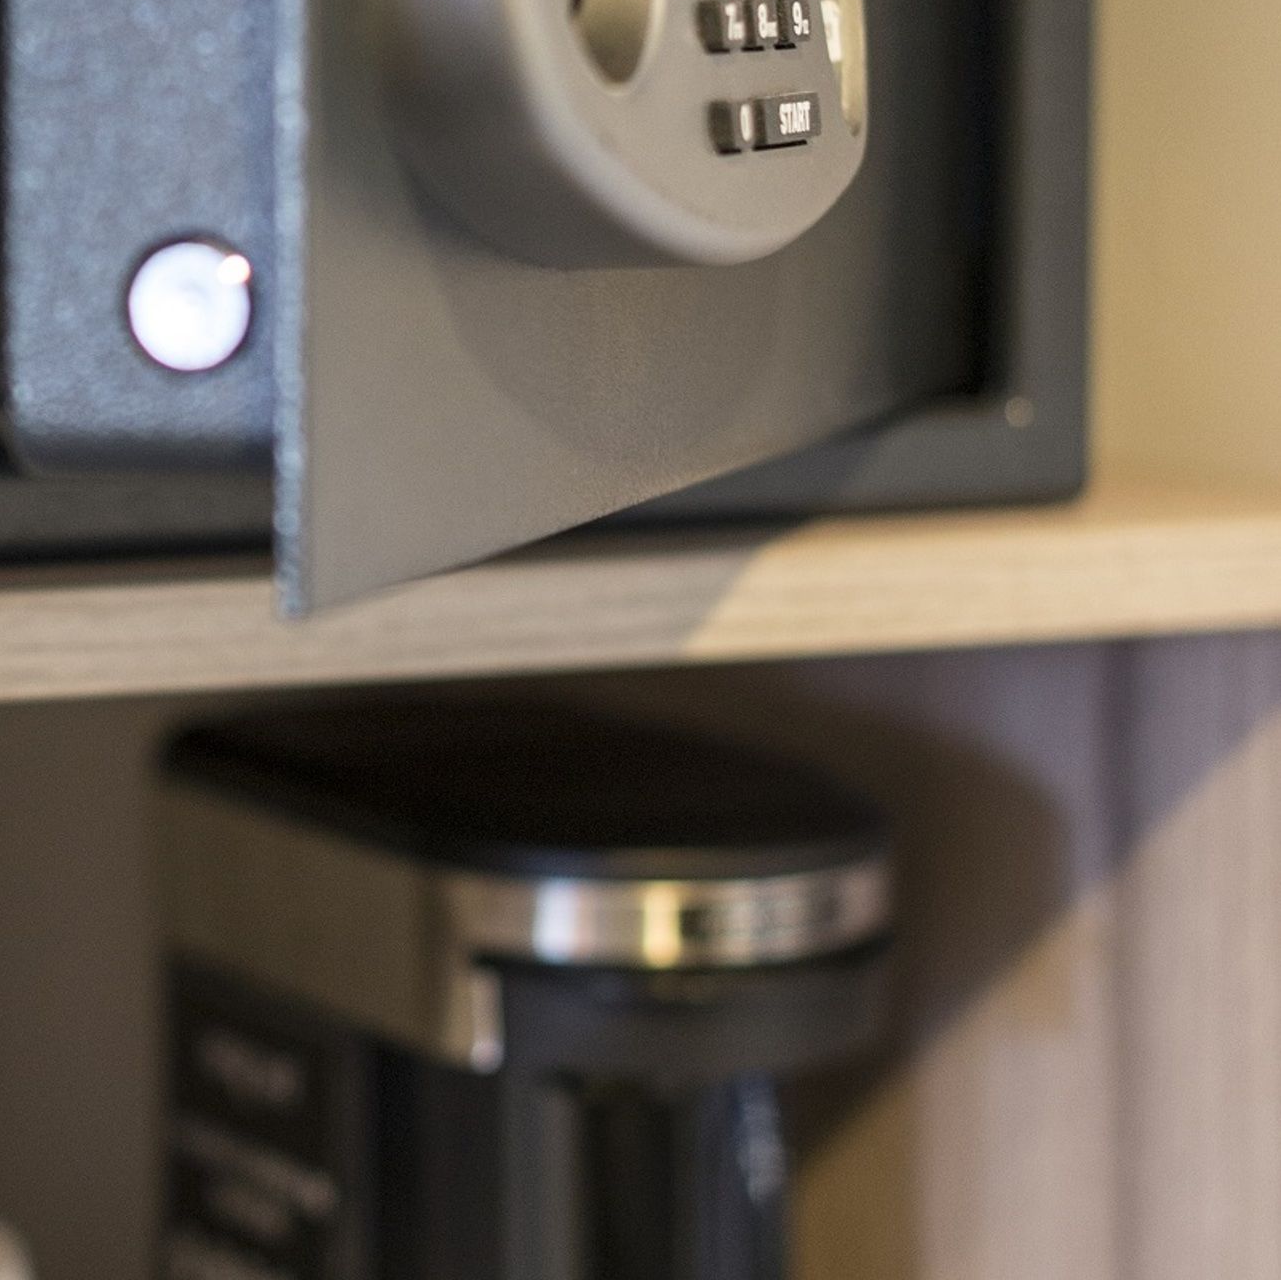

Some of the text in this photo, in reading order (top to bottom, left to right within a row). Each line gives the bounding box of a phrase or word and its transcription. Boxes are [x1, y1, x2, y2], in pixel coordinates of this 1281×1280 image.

[725, 3, 736, 40] 7
[758, 3, 767, 38] 8
[792, 2, 802, 36] 9
[779, 101, 811, 135] START
